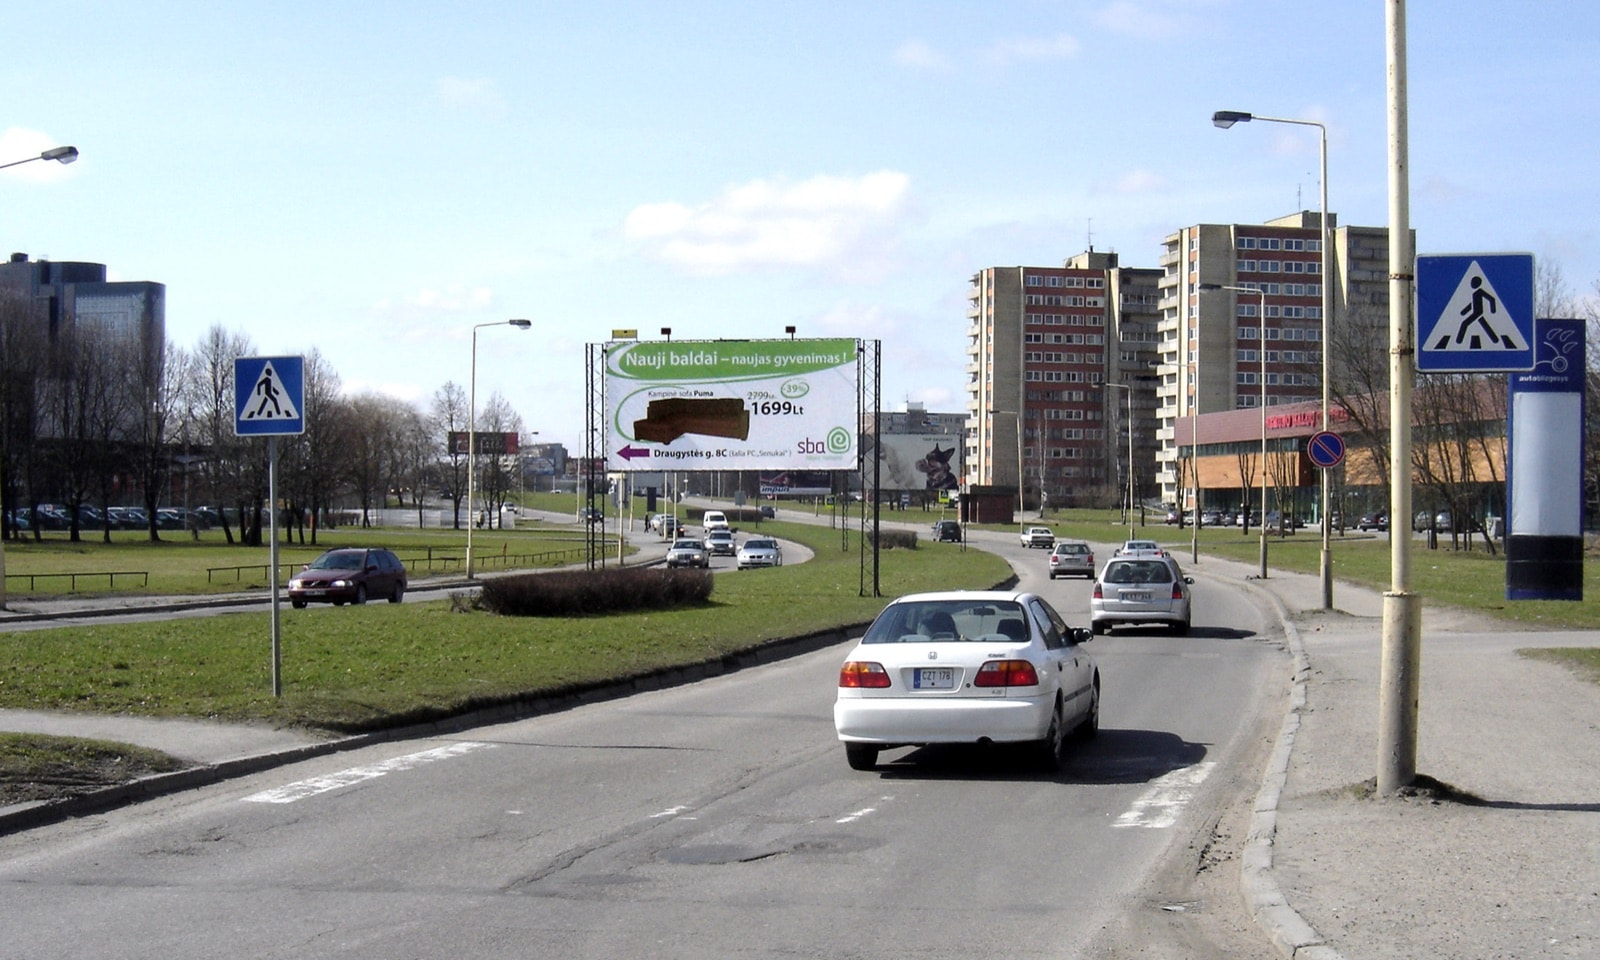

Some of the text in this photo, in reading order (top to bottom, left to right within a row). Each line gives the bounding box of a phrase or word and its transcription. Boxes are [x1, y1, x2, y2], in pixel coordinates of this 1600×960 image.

[626, 352, 666, 369] Nauji
[670, 350, 717, 366] baldai
[731, 354, 771, 367] naujas
[774, 353, 840, 367] gyvenimas
[797, 437, 826, 454] sba
[654, 448, 703, 460] Draugystės
[705, 450, 714, 460] g.
[716, 448, 728, 458] 8C
[922, 671, 936, 681] CZT
